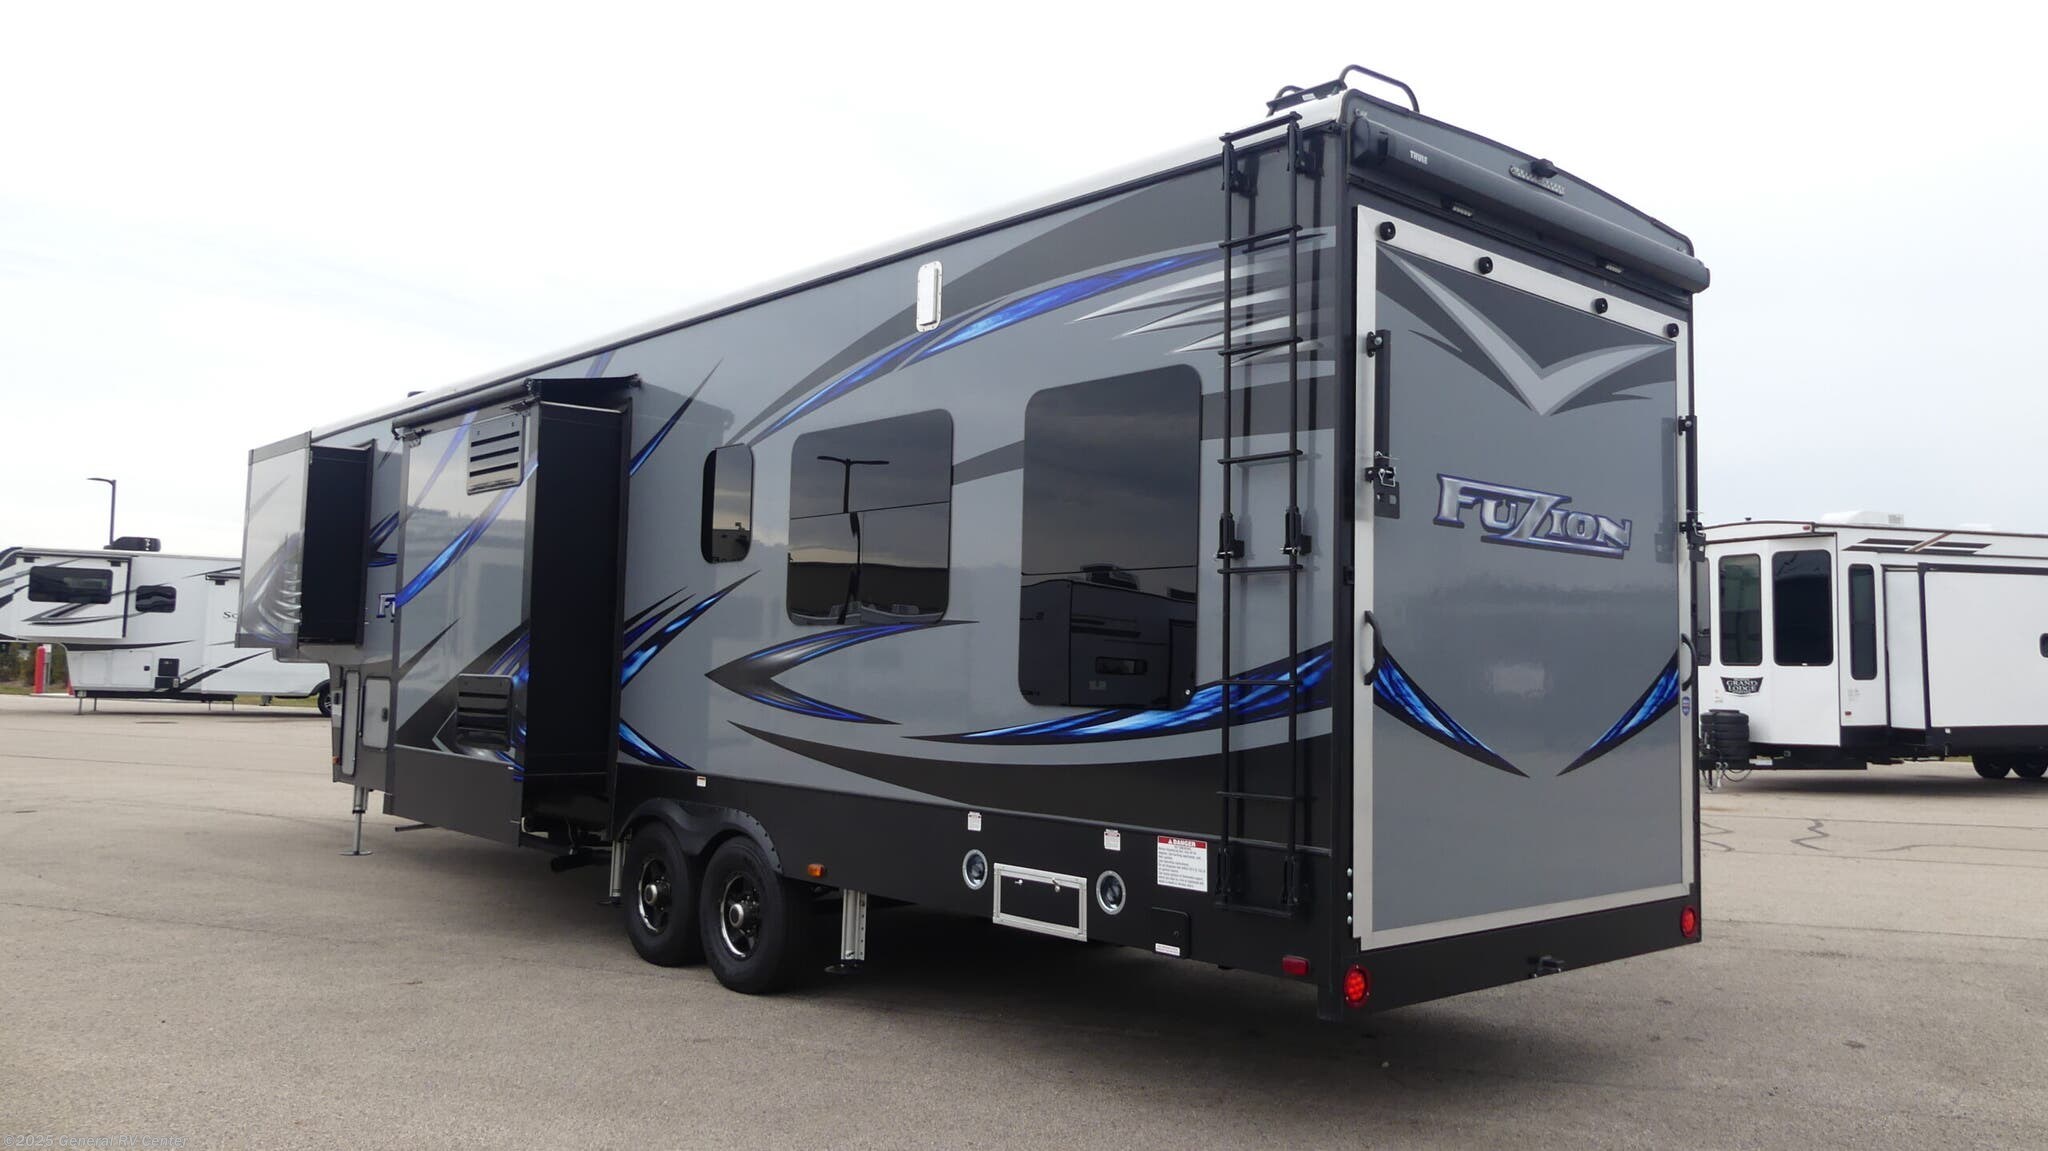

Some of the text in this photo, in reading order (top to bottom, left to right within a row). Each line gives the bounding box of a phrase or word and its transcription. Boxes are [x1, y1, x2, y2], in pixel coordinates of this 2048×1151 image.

[1410, 150, 1428, 165] THULE
[1726, 679, 1758, 687] GRAND
[1173, 838, 1196, 848] DANGER
